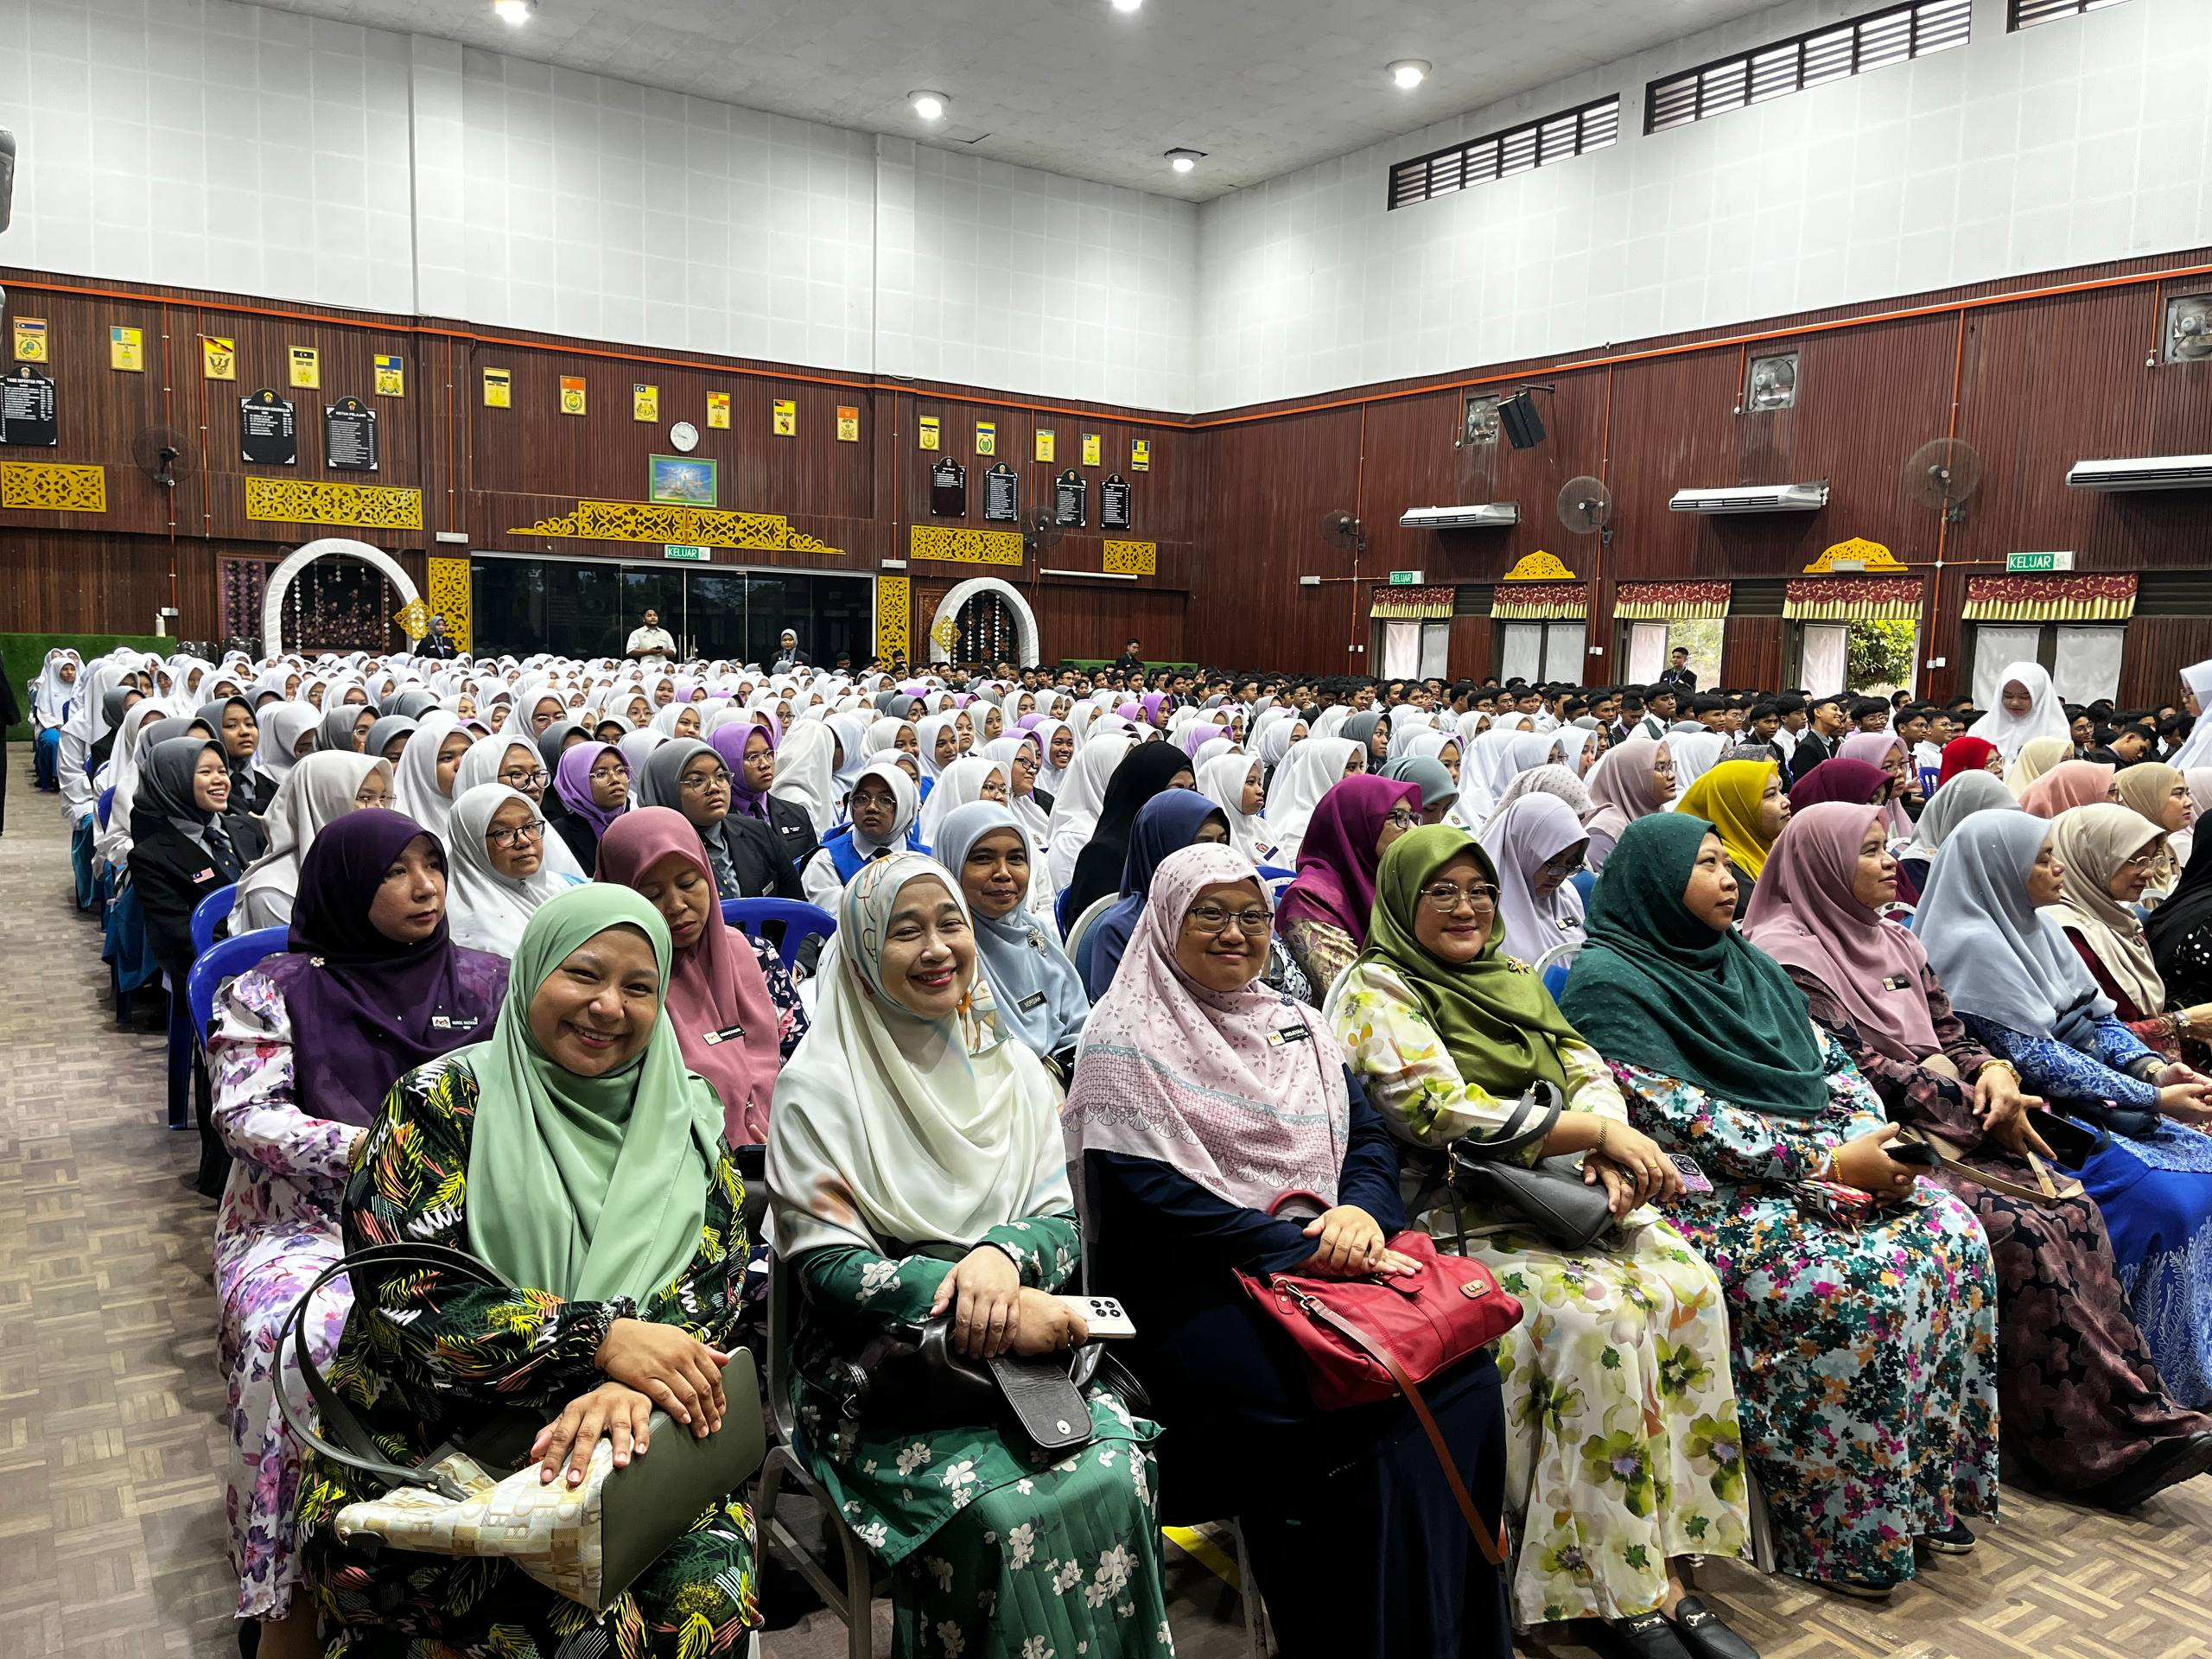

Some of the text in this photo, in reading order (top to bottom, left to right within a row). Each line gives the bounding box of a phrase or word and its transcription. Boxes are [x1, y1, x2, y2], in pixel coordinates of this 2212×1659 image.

[668, 547, 697, 558] KELUAR
[2009, 556, 2052, 569] KELUAR
[1391, 573, 1412, 583] KELUAR
